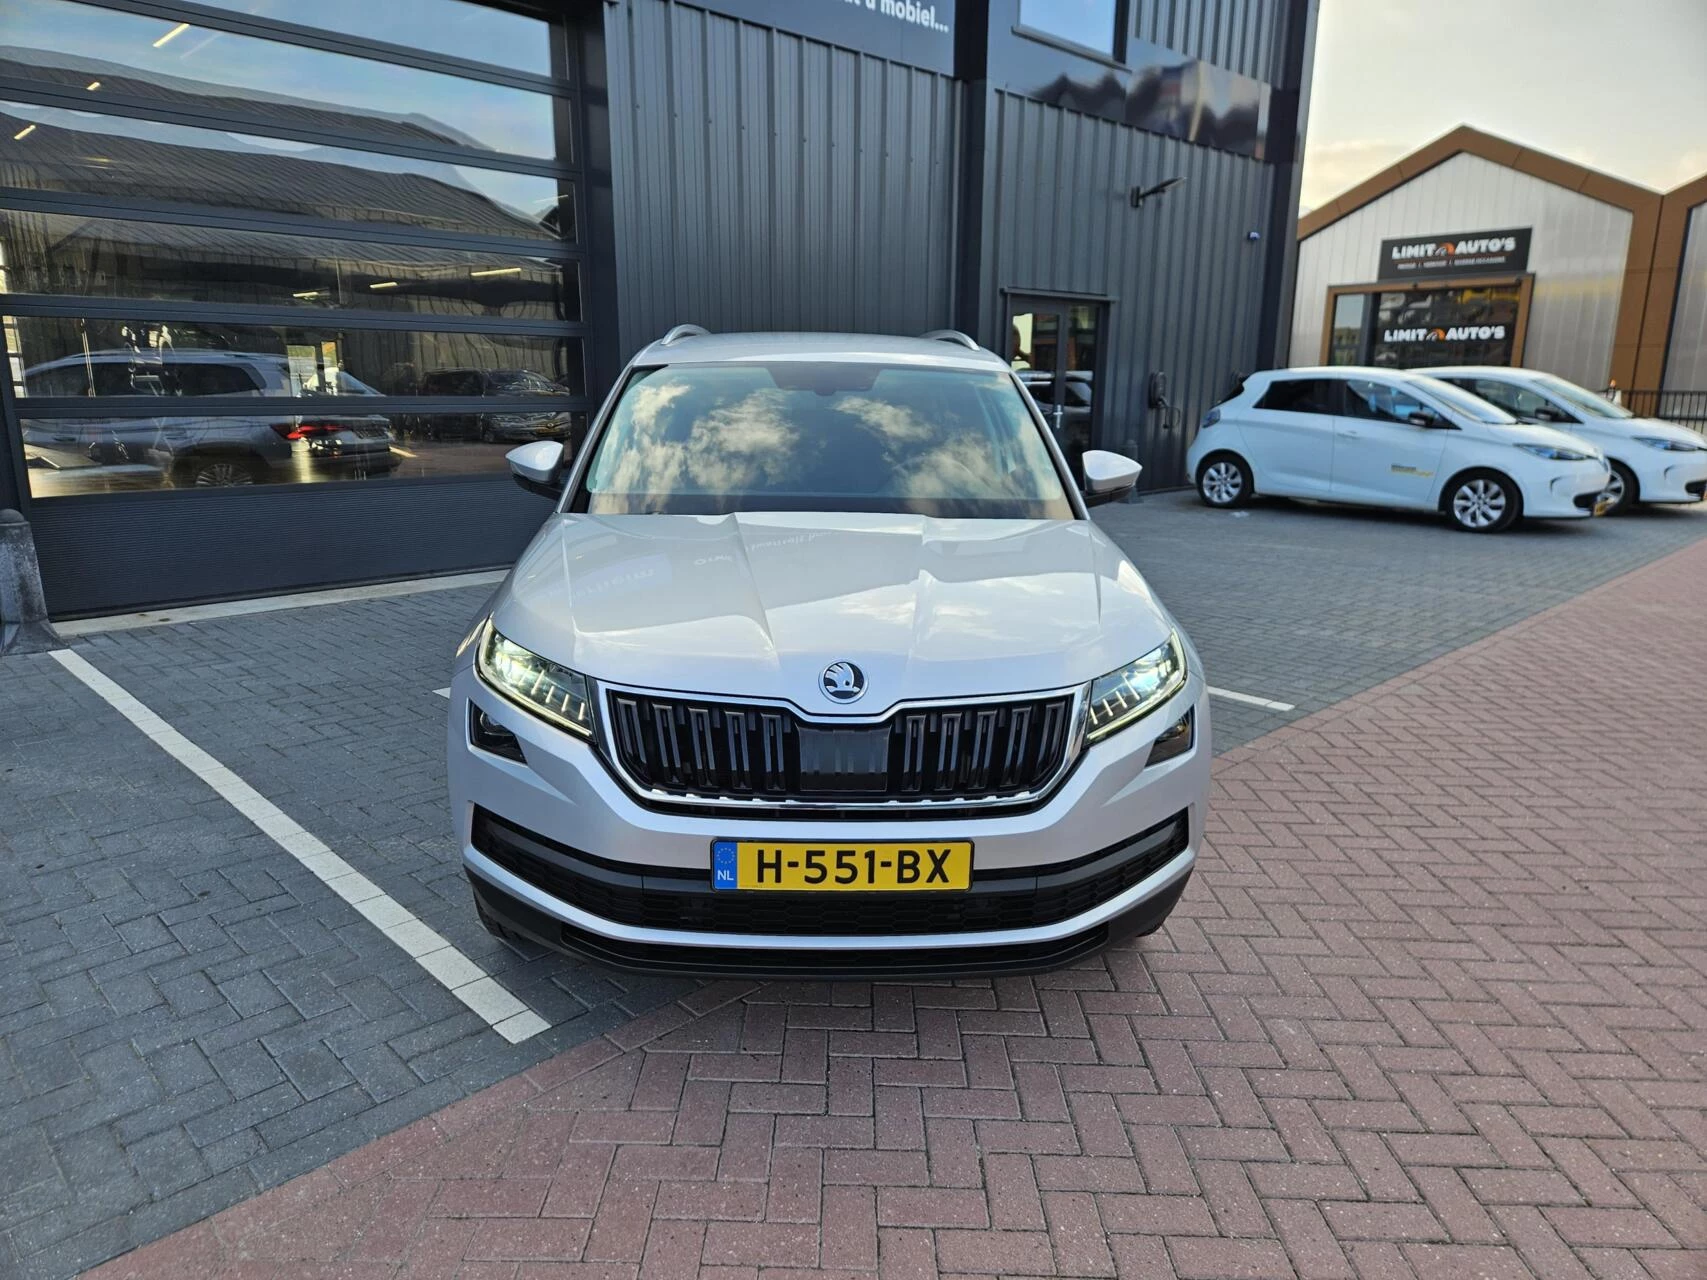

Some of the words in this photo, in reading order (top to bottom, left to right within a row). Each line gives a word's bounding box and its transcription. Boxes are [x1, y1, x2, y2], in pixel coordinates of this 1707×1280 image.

[880, 0, 949, 33] mobiel...
[1391, 243, 1437, 259] LIMIT
[1454, 237, 1516, 255] AUTO'S
[1384, 328, 1428, 342] LIMIT
[1445, 326, 1505, 341] AUTO'S
[717, 870, 734, 881] NL
[757, 849, 951, 884] H-551-BX
